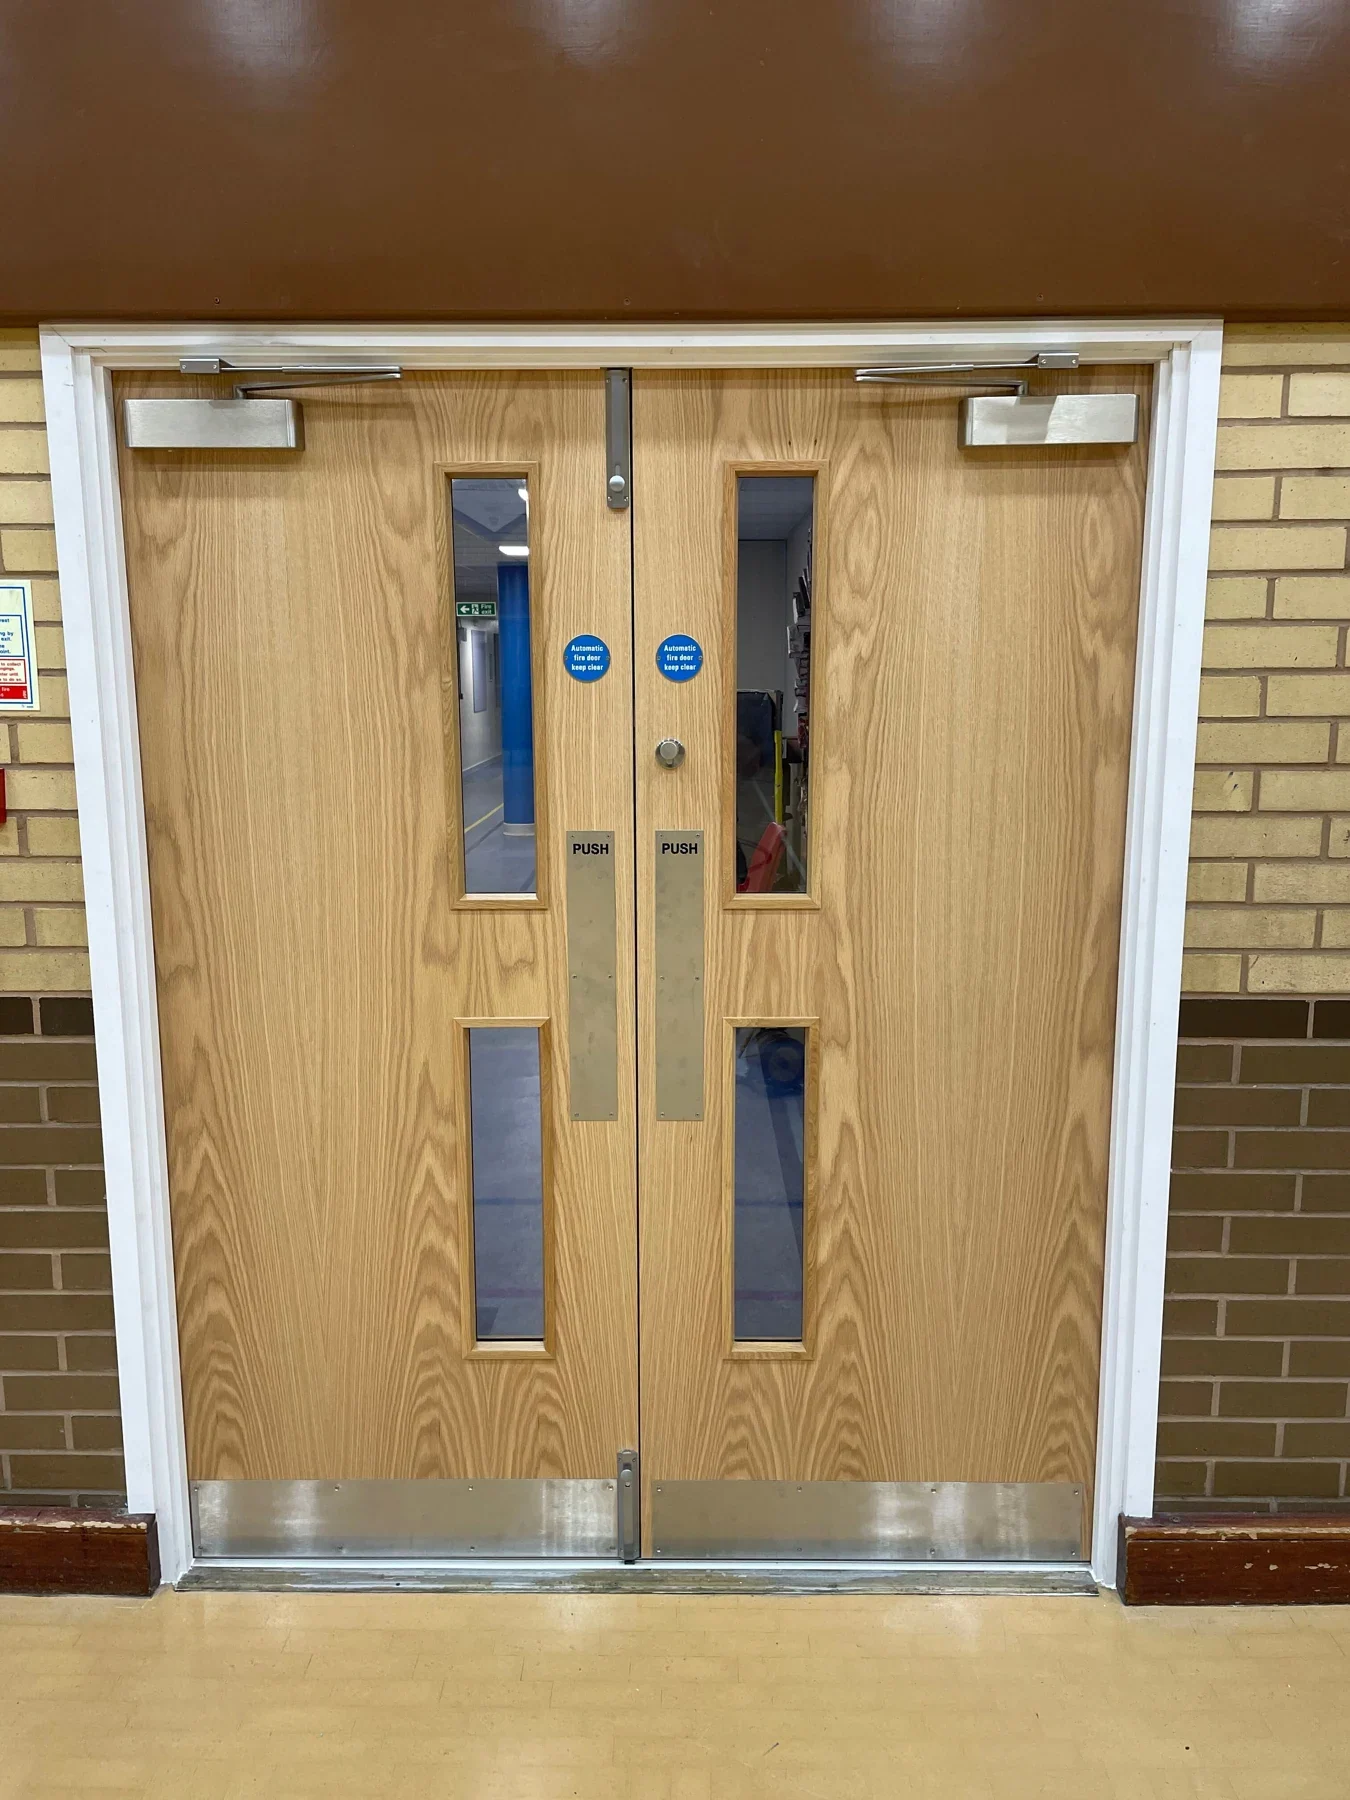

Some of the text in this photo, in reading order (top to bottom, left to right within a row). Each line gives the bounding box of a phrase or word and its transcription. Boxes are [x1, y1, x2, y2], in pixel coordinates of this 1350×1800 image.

[571, 644, 604, 652] Automatic
[663, 644, 697, 652] Automatic
[571, 664, 587, 672] keep
[664, 664, 680, 672] keep
[573, 843, 609, 855] PUSH
[662, 843, 698, 855] PUSH
